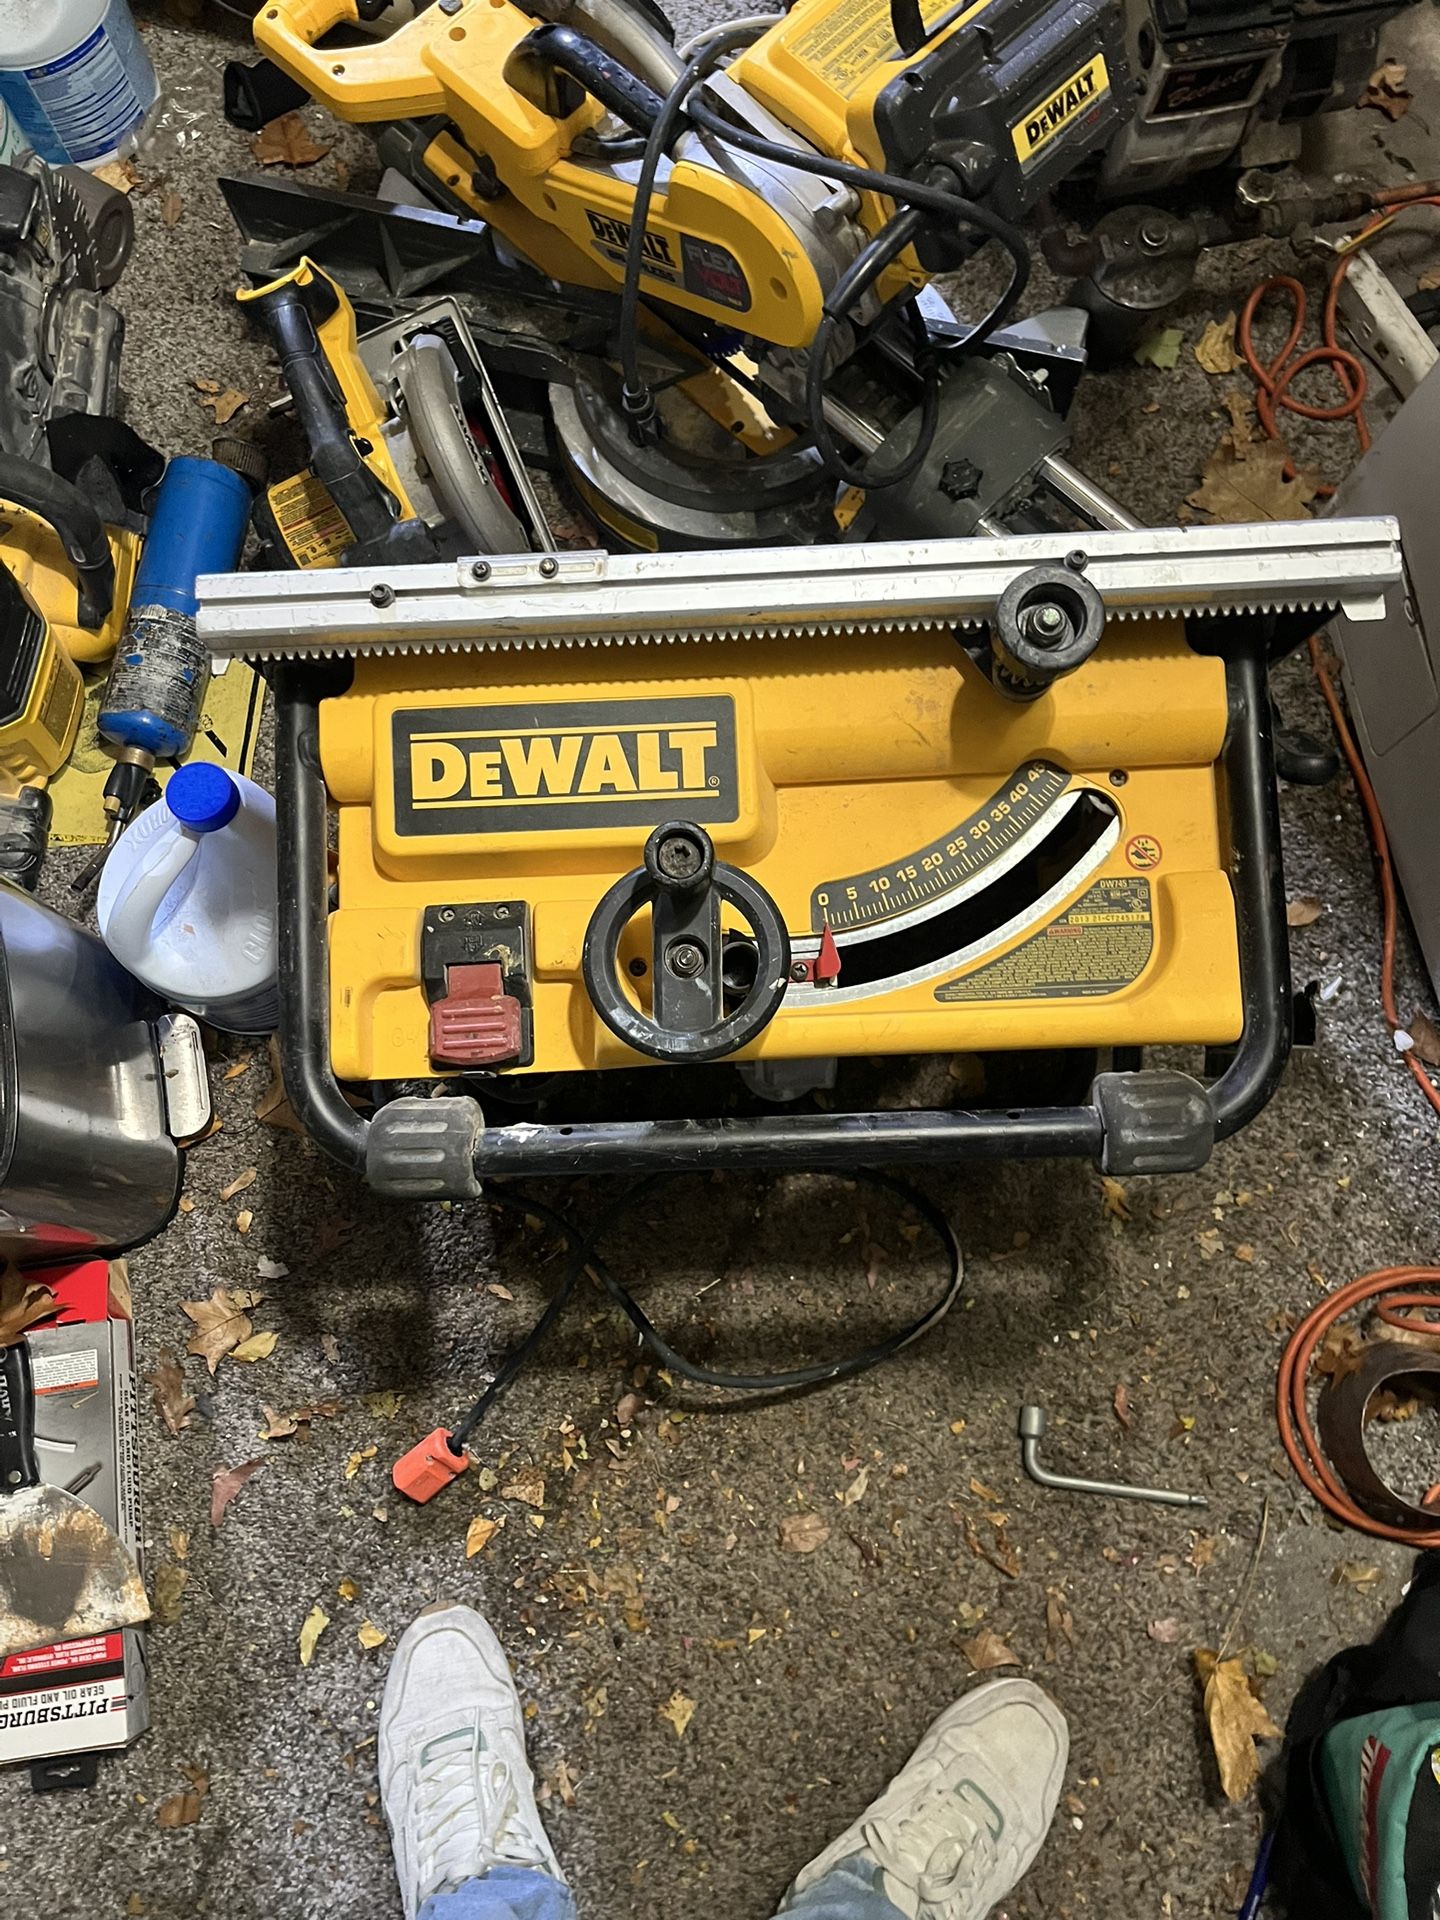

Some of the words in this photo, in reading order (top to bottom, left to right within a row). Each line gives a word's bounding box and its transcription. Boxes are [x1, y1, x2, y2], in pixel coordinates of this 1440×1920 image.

[1026, 70, 1095, 144] DEWALT
[410, 730, 717, 800] DEWALT
[817, 892, 829, 906] 0
[846, 887, 858, 901] 5
[869, 876, 891, 893] 10
[896, 865, 918, 883] 15
[921, 852, 944, 872] 20
[946, 836, 968, 857] 25
[969, 819, 991, 840] 30
[990, 801, 1011, 822] 35
[1009, 782, 1030, 803] 40
[129, 1373, 142, 1542] PITTSBURGH
[12, 1695, 38, 1709] FLUID
[41, 1692, 59, 1704] AND
[63, 1689, 77, 1700] OIL
[80, 1685, 105, 1698] GEAR
[0, 1698, 109, 1729] PITTSBURG
